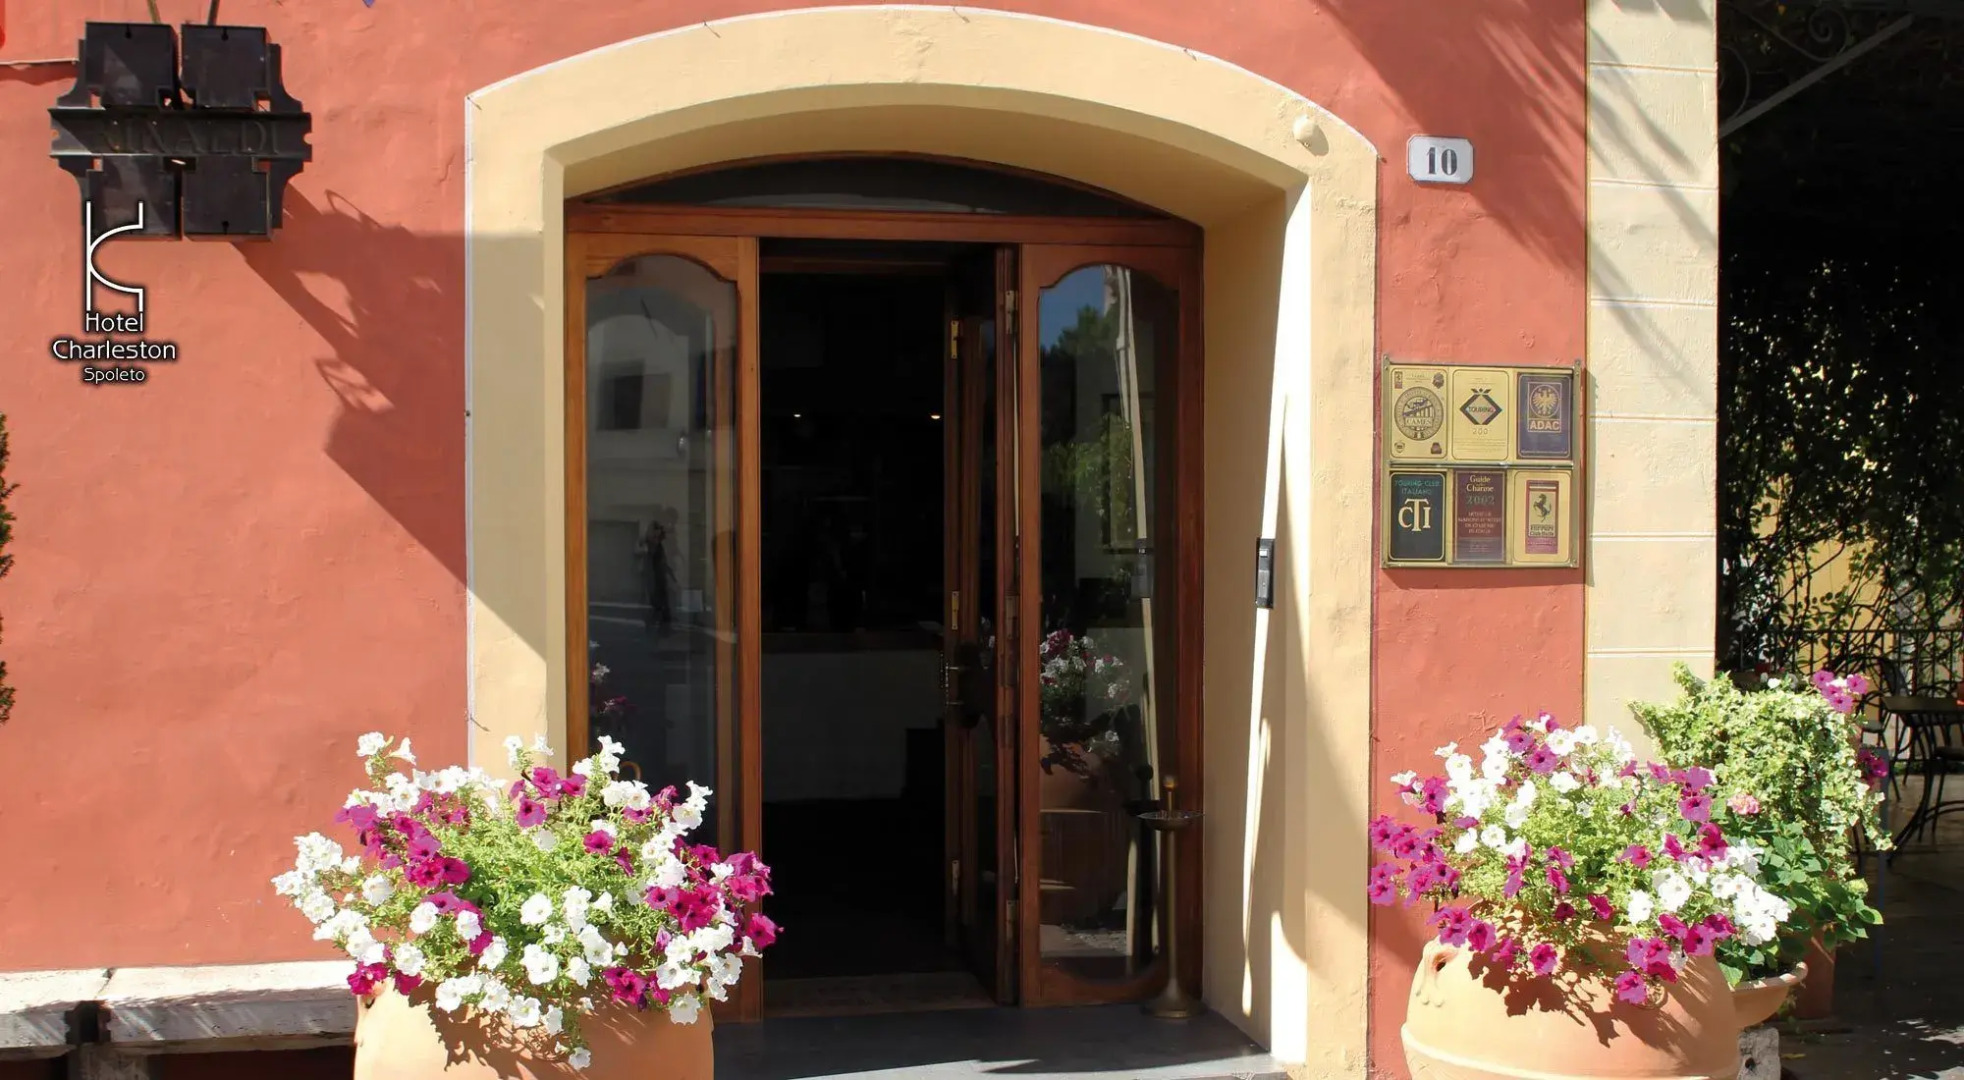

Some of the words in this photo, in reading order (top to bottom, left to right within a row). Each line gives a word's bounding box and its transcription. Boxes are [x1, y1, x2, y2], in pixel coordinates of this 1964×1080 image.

[1426, 146, 1458, 176] 10
[1530, 420, 1560, 430] ADAC
[1469, 474, 1491, 483] Guide
[1466, 483, 1494, 492] Charme
